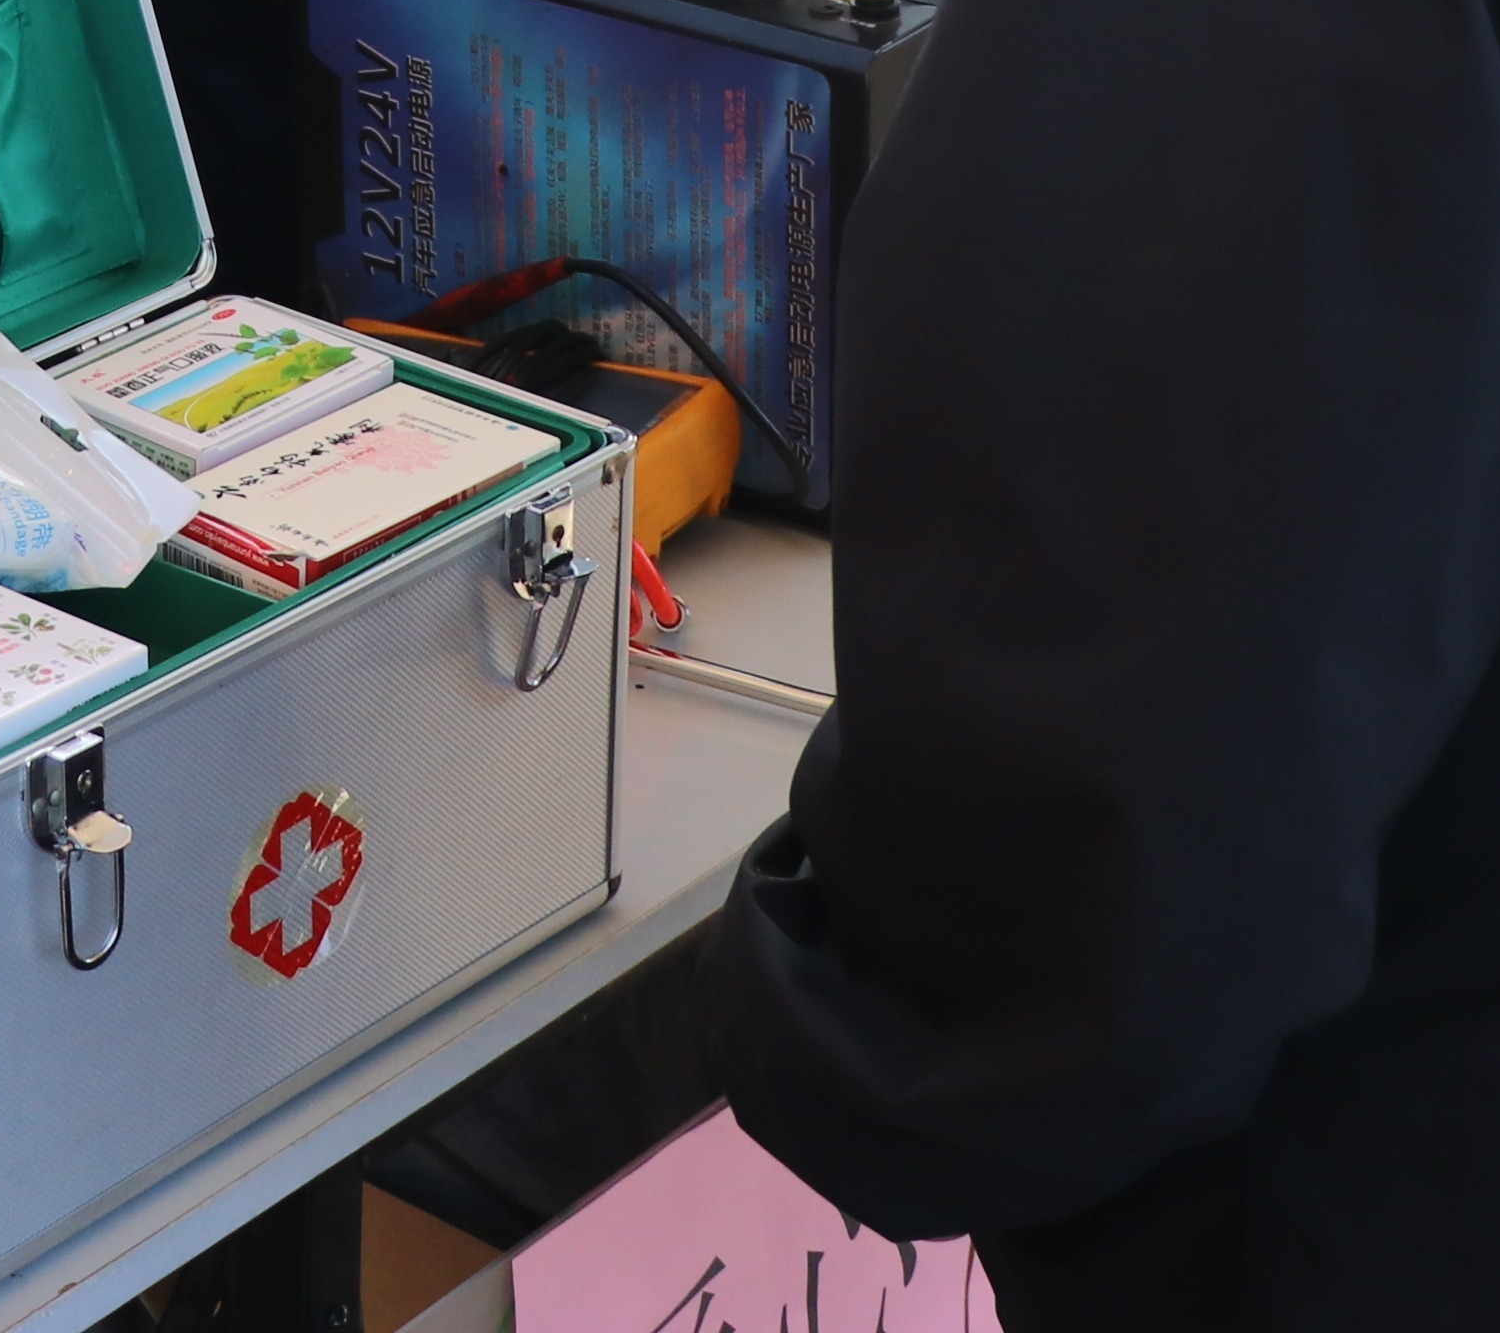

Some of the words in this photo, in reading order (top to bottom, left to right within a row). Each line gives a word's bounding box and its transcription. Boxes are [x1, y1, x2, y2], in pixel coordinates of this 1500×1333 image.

[356, 38, 404, 285] 12V24V
[408, 53, 437, 297] 汽车应急启动电源
[0, 496, 28, 558] Bandage
